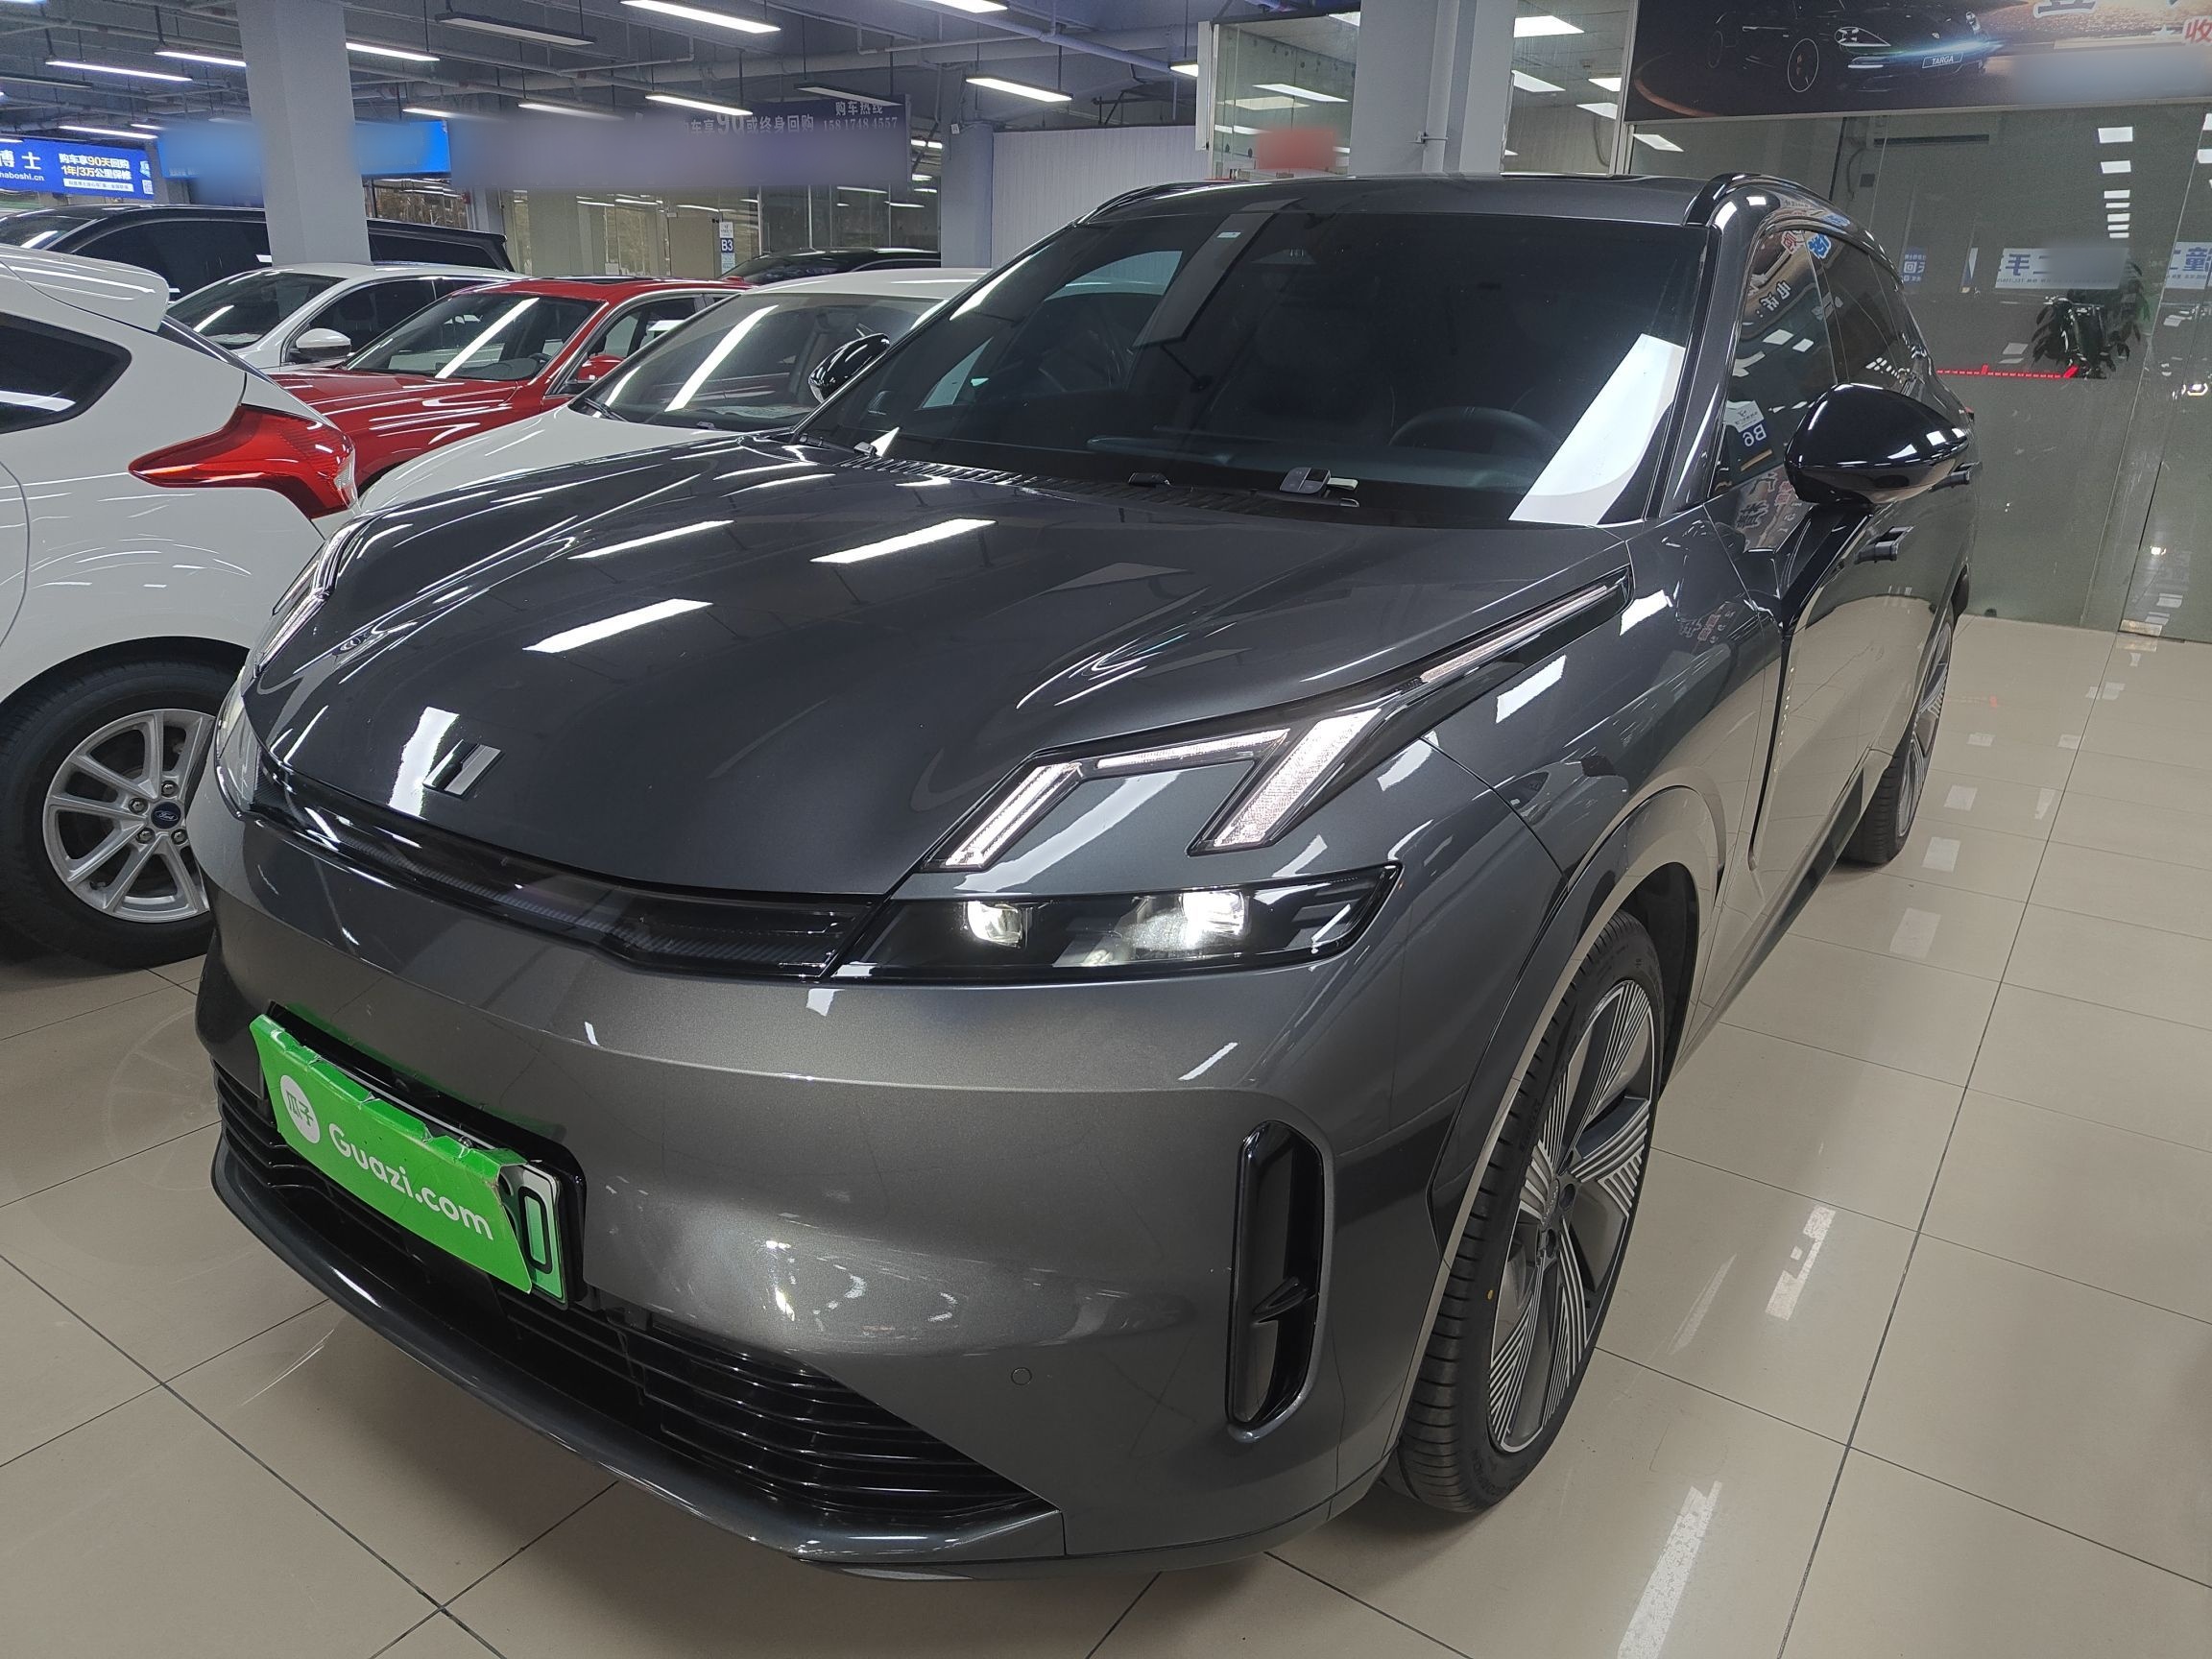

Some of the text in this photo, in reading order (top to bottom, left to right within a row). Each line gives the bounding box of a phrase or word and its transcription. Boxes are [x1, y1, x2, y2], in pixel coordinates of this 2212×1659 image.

[1932, 55, 1954, 65] TARGA
[721, 239, 733, 252] B3
[286, 1090, 314, 1128] 瓜子
[328, 1122, 493, 1241] Guazi.com
